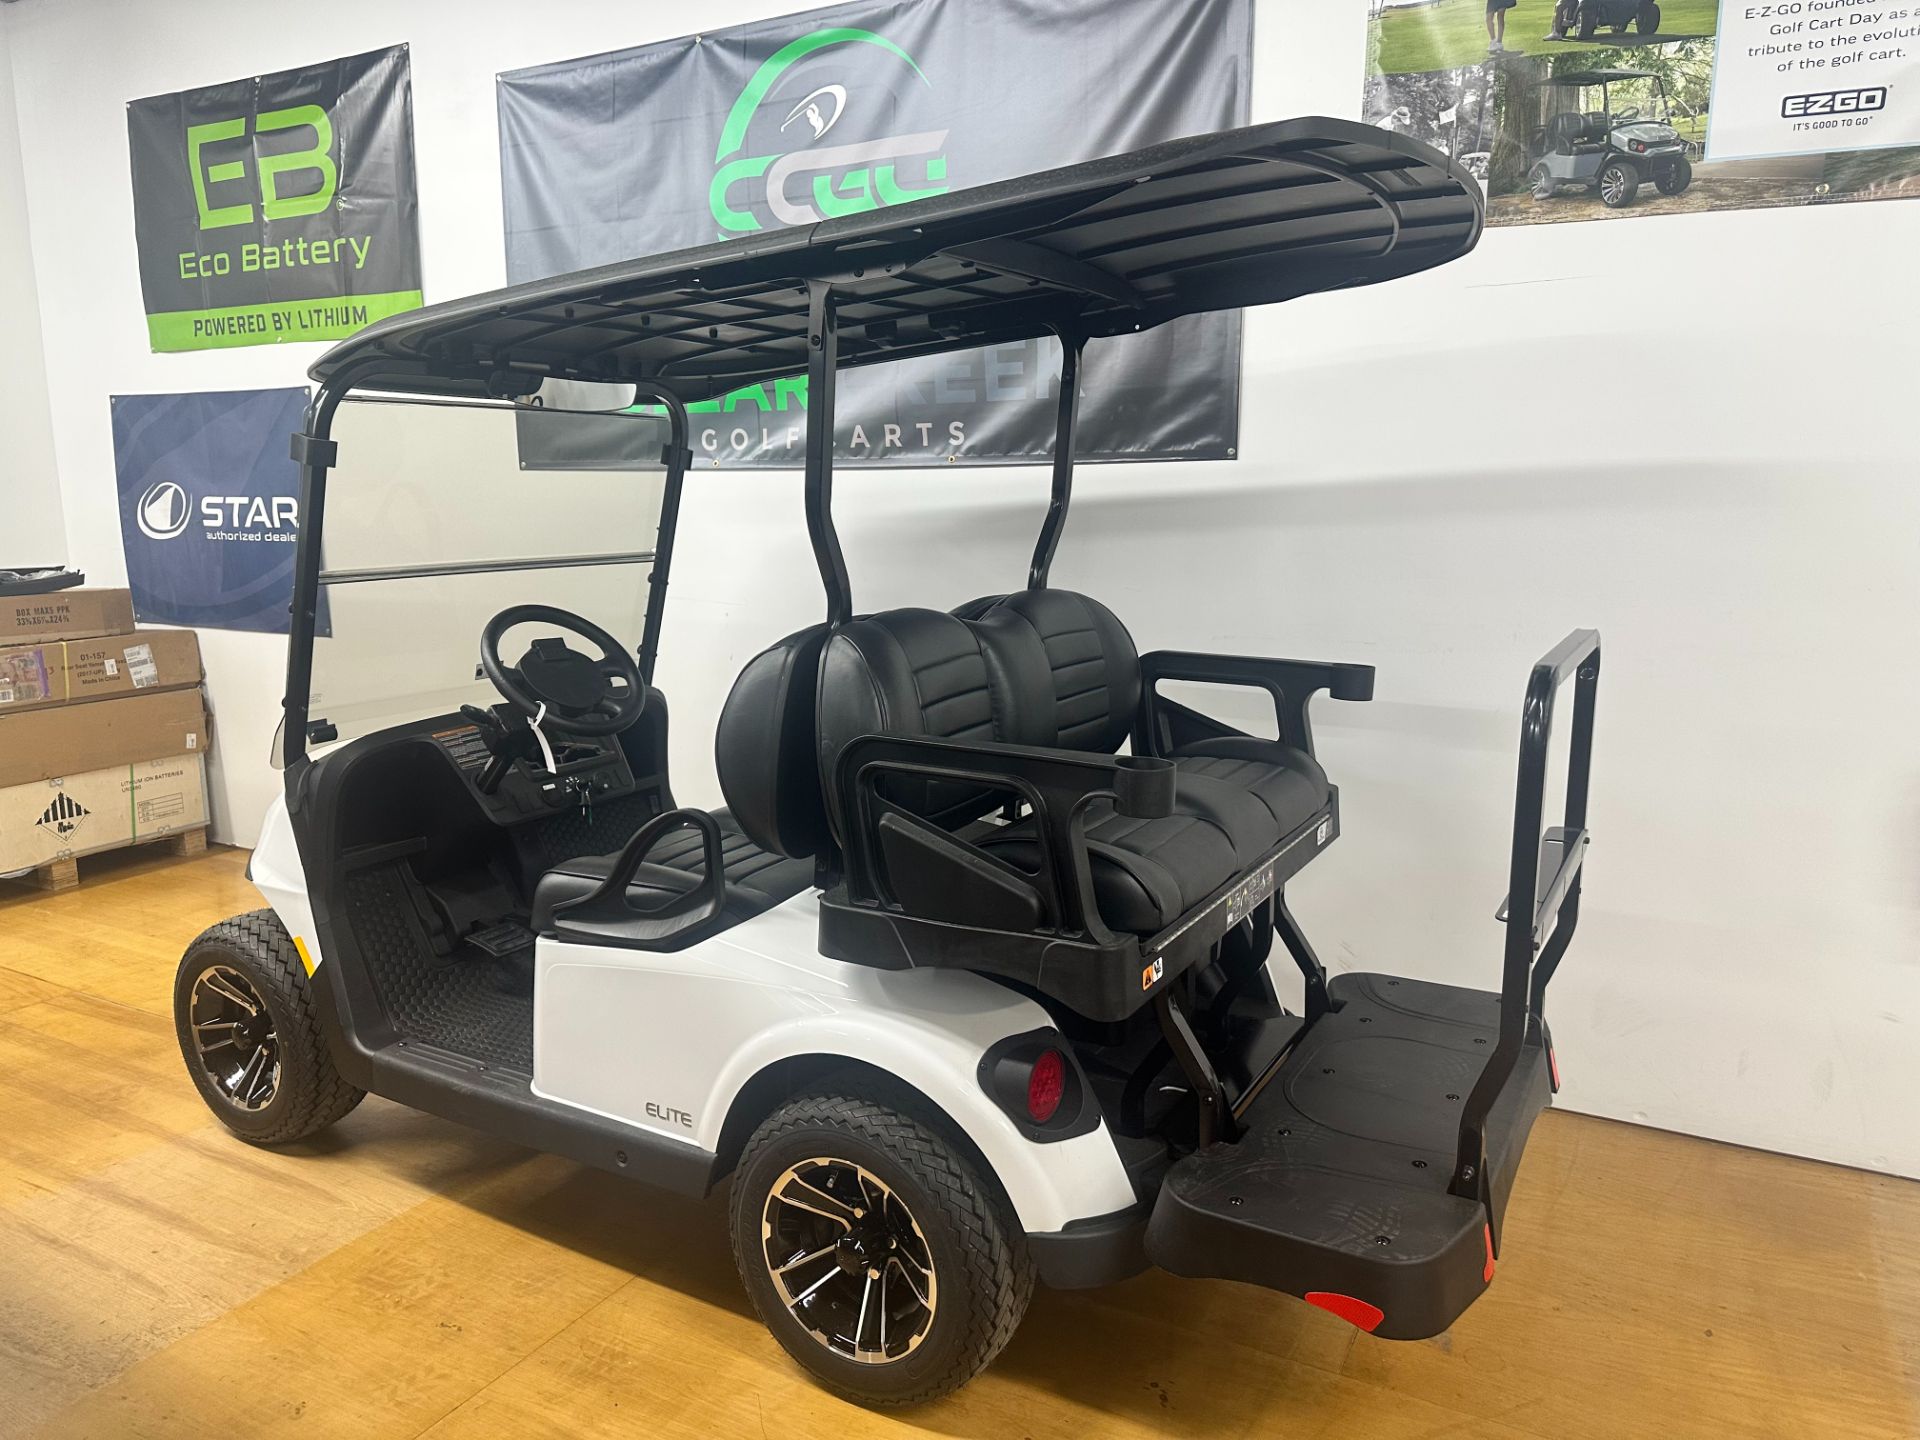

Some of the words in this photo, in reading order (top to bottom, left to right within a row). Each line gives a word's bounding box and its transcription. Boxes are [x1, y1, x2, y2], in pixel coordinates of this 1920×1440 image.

[1744, 3, 1802, 20] E-Z-GO
[1769, 21, 1804, 36] Golf
[1808, 16, 1844, 31] Cart
[1849, 12, 1884, 25] Day
[1888, 7, 1908, 20] as
[1748, 42, 1803, 58] tribute
[1807, 39, 1825, 50] to
[1829, 34, 1858, 47] the
[1776, 59, 1795, 73] of
[1798, 56, 1826, 70] the
[1830, 51, 1864, 68] golf
[1868, 47, 1907, 61] cart.
[1783, 88, 1885, 117] EZGO
[1792, 122, 1811, 132] IT'S
[1812, 120, 1839, 131] GOOD
[1841, 118, 1854, 127] TO
[186, 103, 338, 231] EB
[178, 251, 231, 280] Eco
[241, 235, 372, 274] Battery
[193, 313, 267, 338] POWERED
[273, 310, 293, 331] BY
[298, 305, 369, 330] LITHIUM
[700, 427, 800, 454] GOLF
[832, 421, 967, 450] ARTS
[200, 496, 300, 529] STAR
[206, 531, 262, 541] authorized
[264, 531, 297, 542] deale
[79, 652, 106, 662] 01-157
